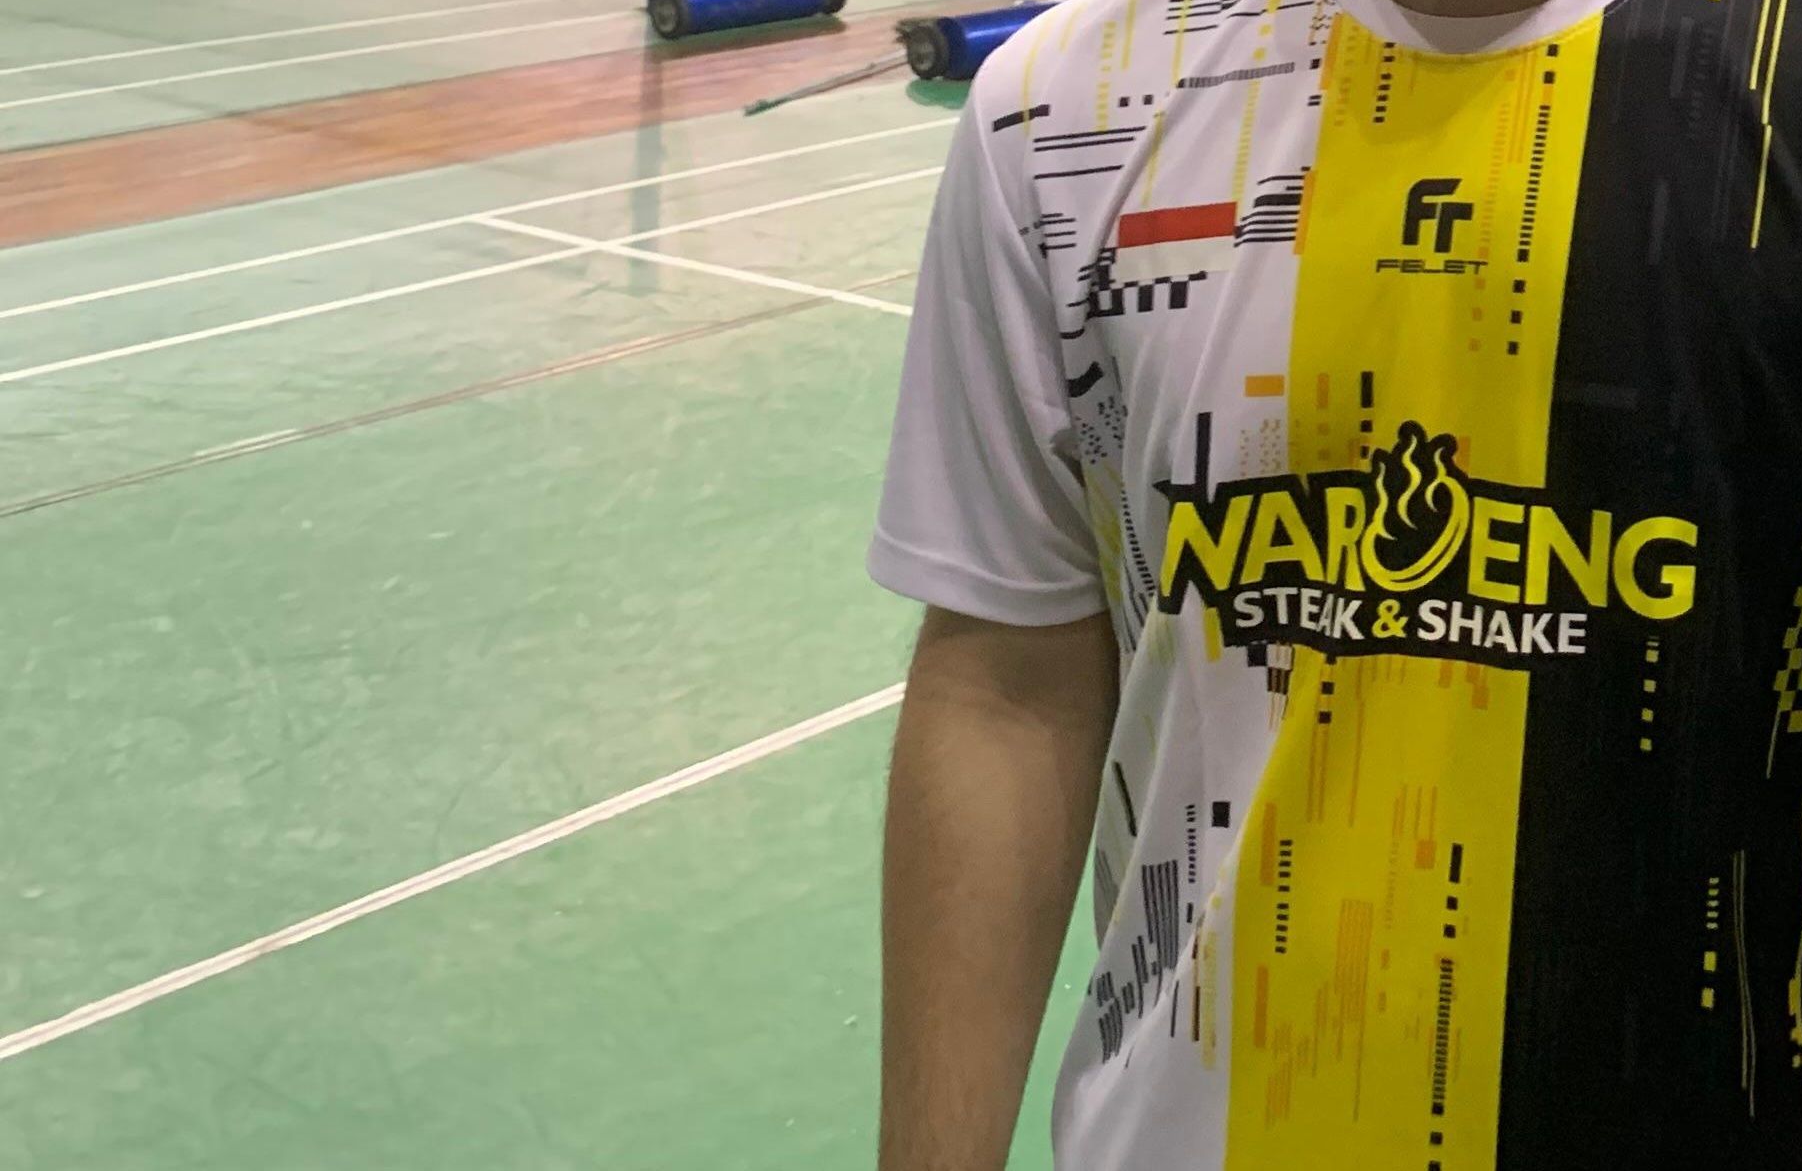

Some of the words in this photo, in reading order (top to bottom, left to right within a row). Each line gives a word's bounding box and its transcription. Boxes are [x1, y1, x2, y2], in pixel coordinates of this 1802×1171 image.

[1376, 259, 1488, 275] FELET
[1232, 586, 1366, 641] STEAK
[1371, 598, 1409, 638] &
[1416, 599, 1588, 655] SHAKE
